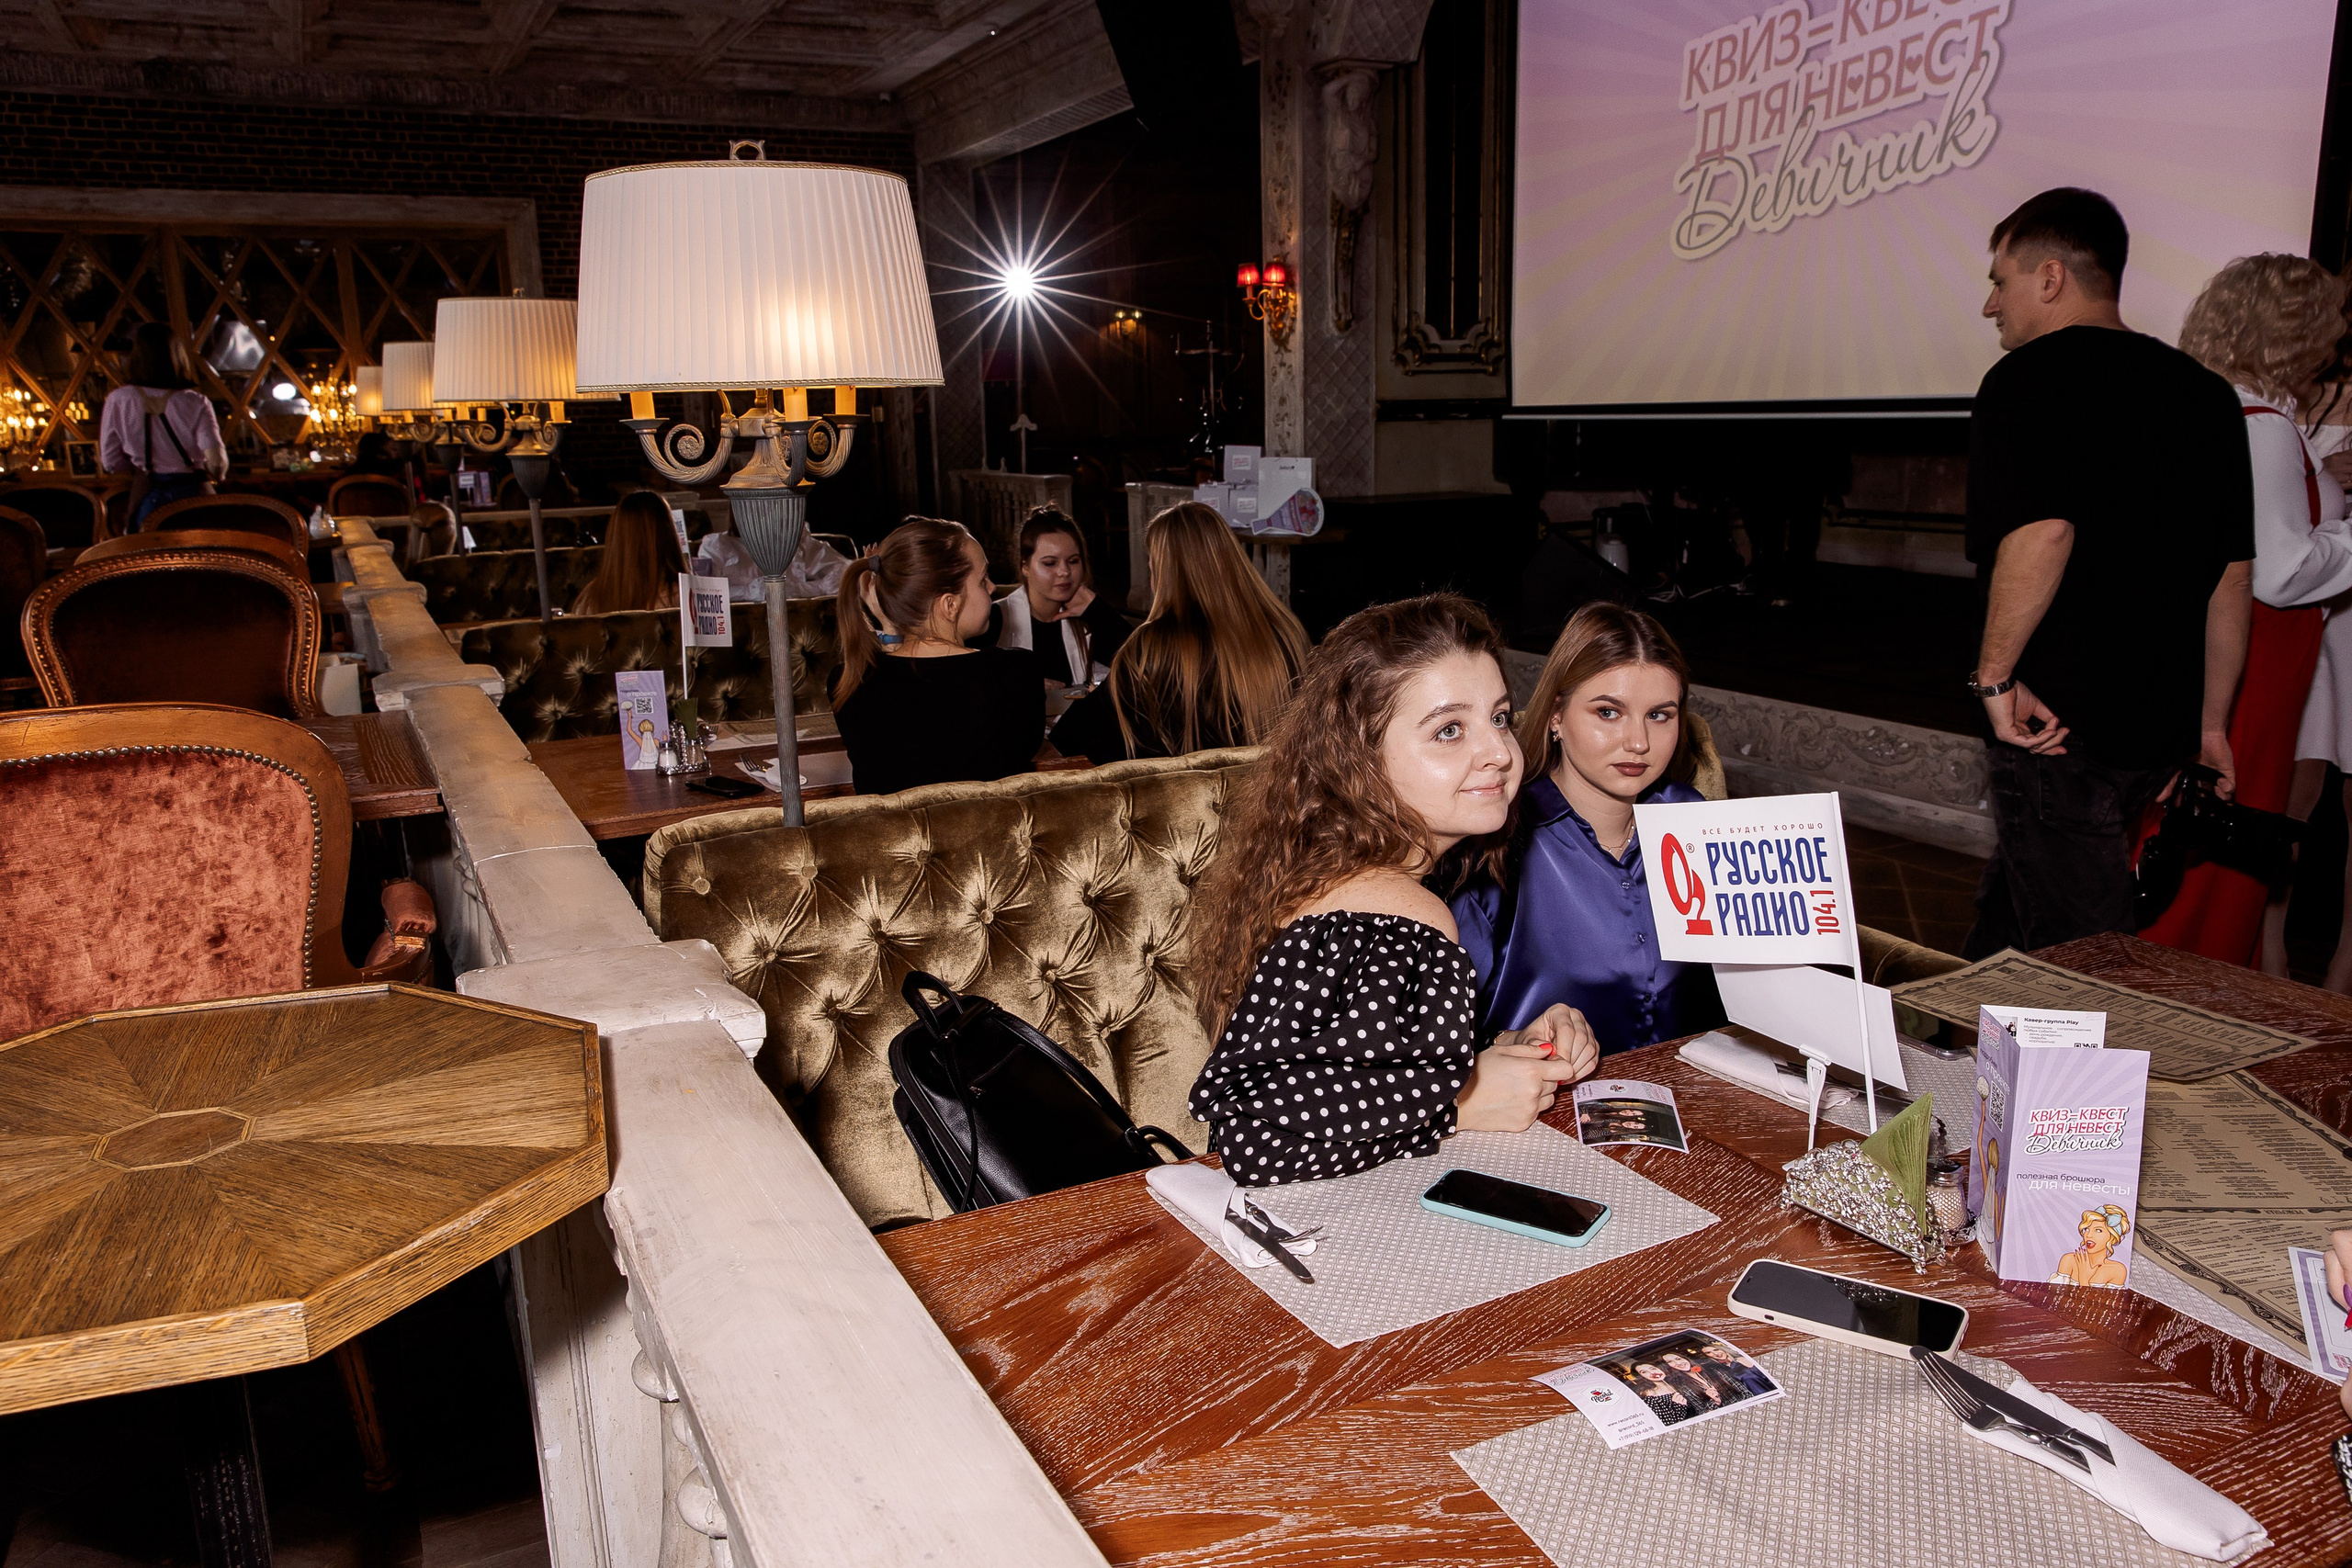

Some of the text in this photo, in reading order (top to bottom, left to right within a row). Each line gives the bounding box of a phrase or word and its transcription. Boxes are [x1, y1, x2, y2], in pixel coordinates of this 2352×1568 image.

[1694, 6, 2000, 171] ДЛЯ НЕВЕСТ
[1730, 825, 1765, 834] БУДЕТ
[1774, 822, 1823, 831] ХОРОШО
[1705, 837, 1833, 886] РУССКОЕ
[1715, 890, 1810, 936] РАДИО
[1809, 890, 1841, 935] 104.1
[2026, 1128, 2121, 1153] Девичник
[2033, 1122, 2123, 1137] ДЛЯ НЕВЕСТ
[2017, 1171, 2106, 1184] полезная брошюра
[2029, 1180, 2131, 1195] для невесты
